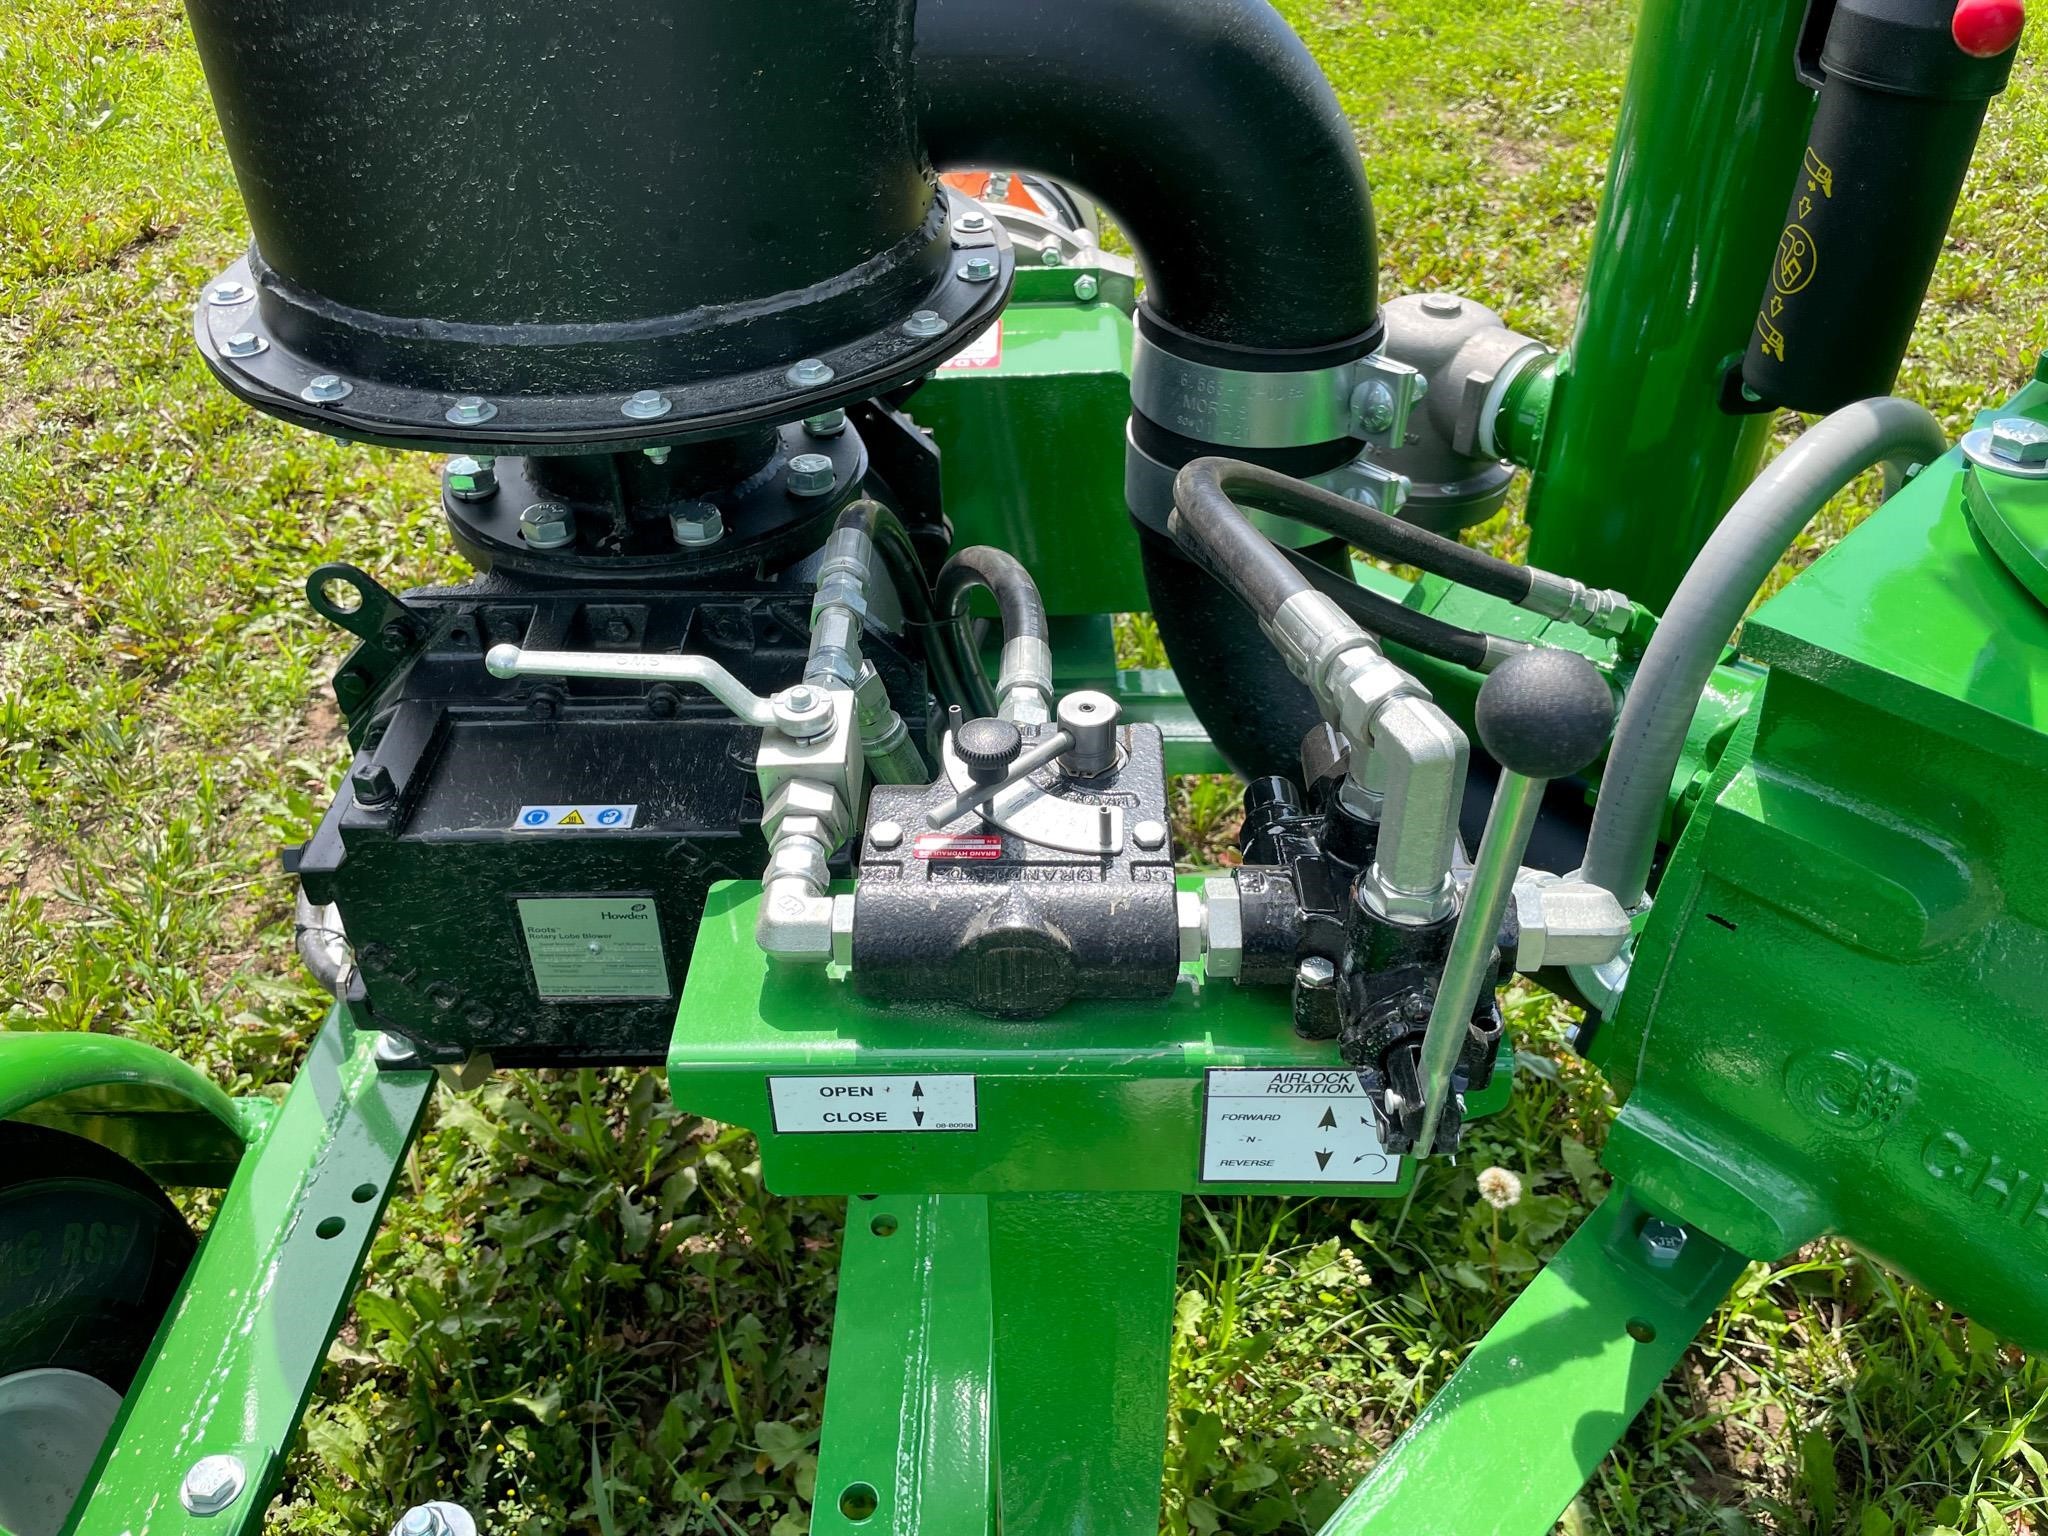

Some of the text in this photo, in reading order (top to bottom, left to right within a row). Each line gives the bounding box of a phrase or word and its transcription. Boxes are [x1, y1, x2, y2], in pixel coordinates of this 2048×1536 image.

[601, 911, 648, 921] Howden
[528, 933, 556, 941] Rotary
[582, 932, 612, 940] Blower
[1270, 1072, 1354, 1084] AIRLOCK
[819, 1086, 874, 1098] OPEN
[1266, 1083, 1355, 1094] ROTATION
[822, 1112, 888, 1123] CLOSE
[1221, 1113, 1281, 1121] FORWARD
[1219, 1159, 1275, 1167] REVERSE
